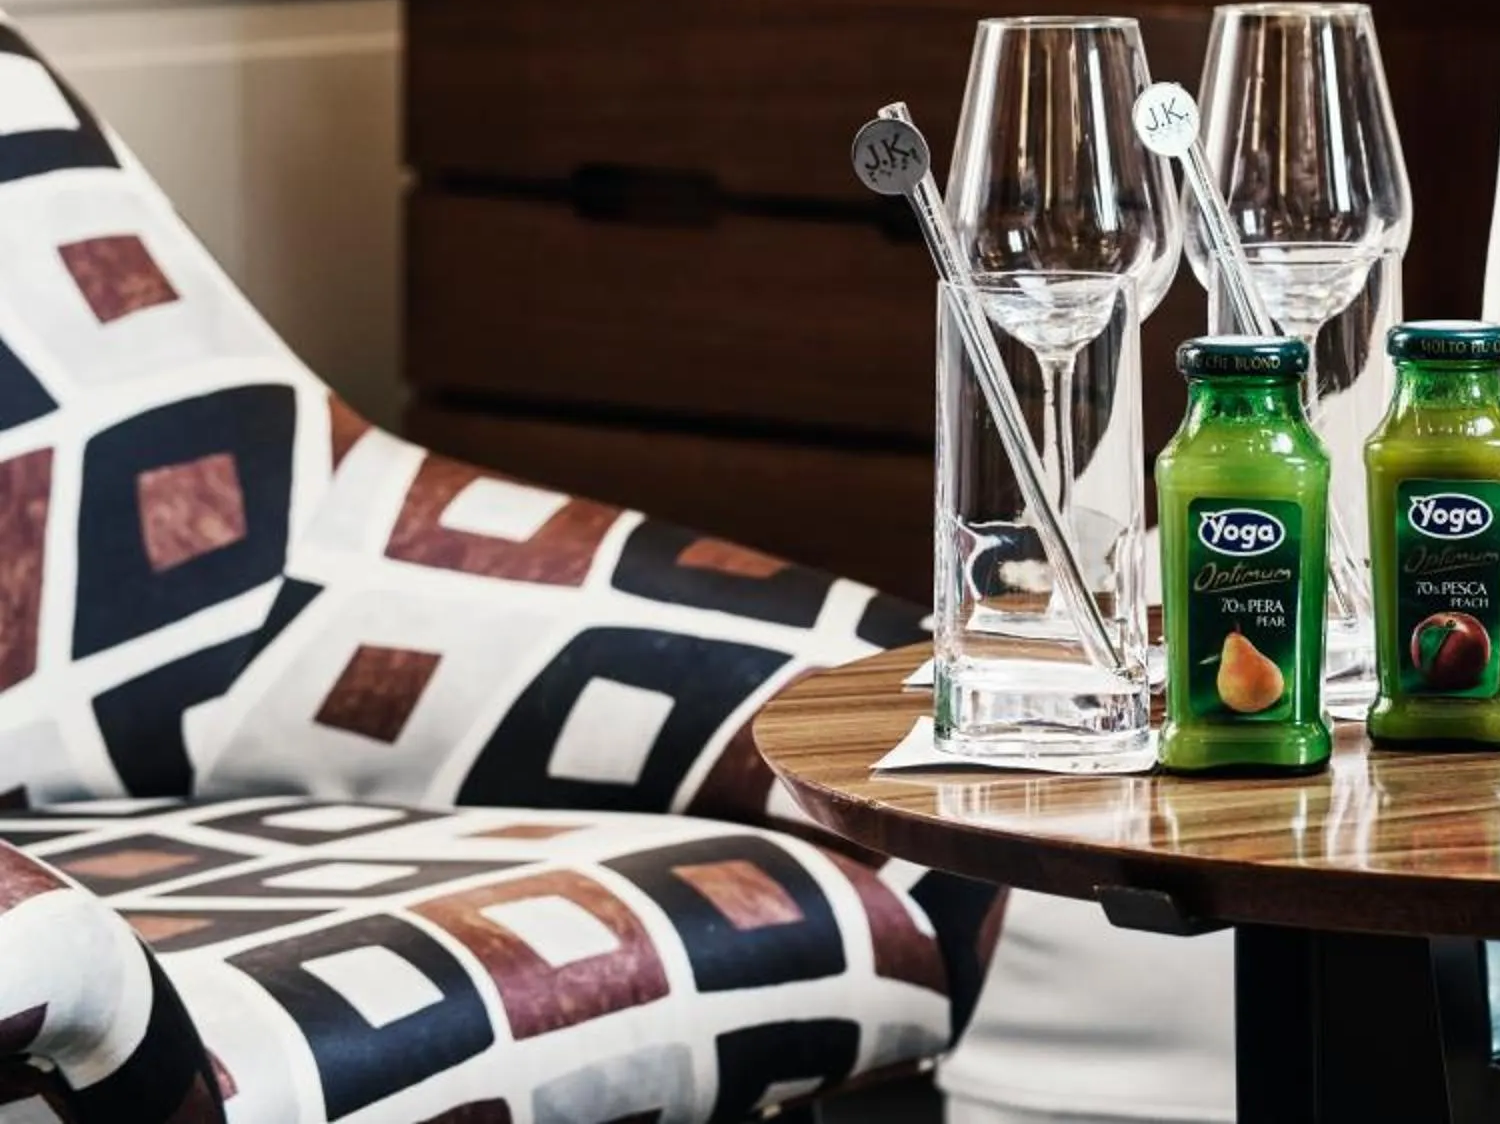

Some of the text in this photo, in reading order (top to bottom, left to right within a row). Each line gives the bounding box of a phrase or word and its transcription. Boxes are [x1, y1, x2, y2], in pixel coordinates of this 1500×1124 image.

[1418, 500, 1483, 532] Yoga
[1209, 515, 1275, 549] Yoga
[1441, 581, 1488, 595] PESCA
[1247, 599, 1285, 614] PERA
[1450, 597, 1489, 608] PEACH
[1256, 615, 1287, 627] PEAR
